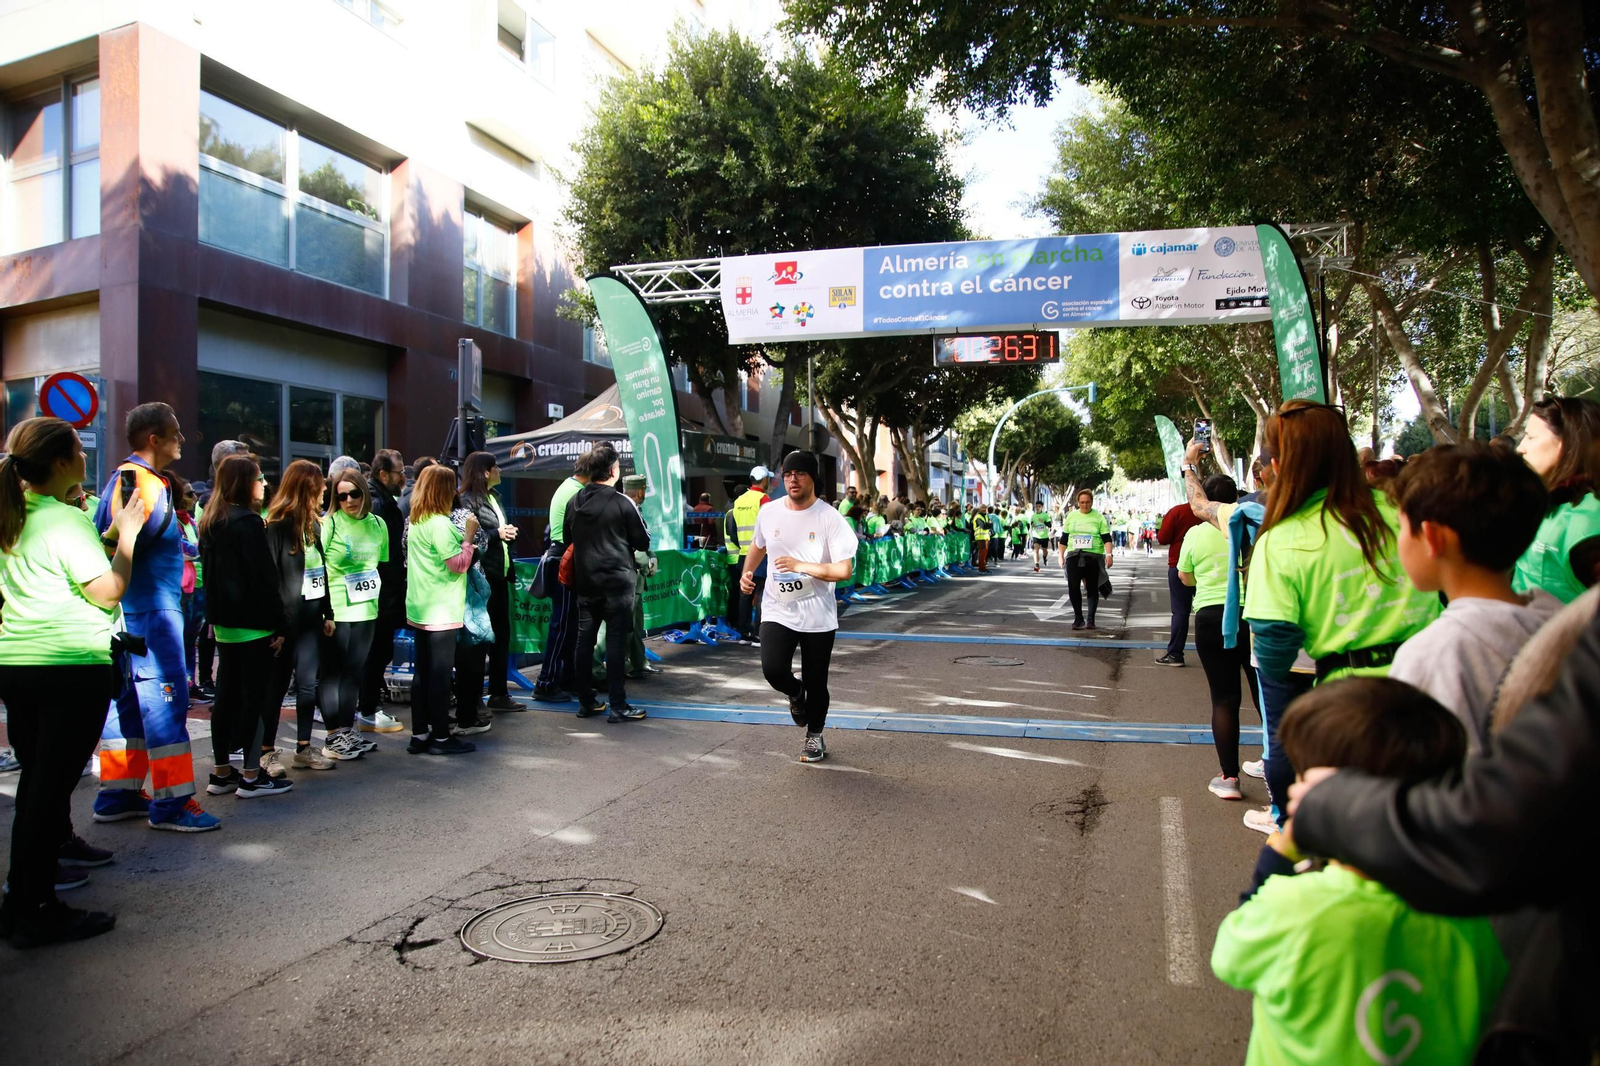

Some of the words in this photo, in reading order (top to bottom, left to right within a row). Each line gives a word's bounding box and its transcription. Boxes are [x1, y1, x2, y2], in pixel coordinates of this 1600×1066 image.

[1150, 243, 1199, 255] cajamar
[879, 251, 968, 274] Almería
[975, 252, 1004, 267] en
[1013, 244, 1104, 265] marcha
[1197, 268, 1254, 281] Fundación
[879, 279, 954, 299] contra
[960, 275, 983, 294] el
[989, 273, 1073, 293] cáncer
[1226, 286, 1246, 296] Ejido
[1183, 300, 1205, 309] Motor
[727, 307, 759, 317] ALMERÍA
[355, 579, 377, 592] 493
[779, 580, 803, 593] 330
